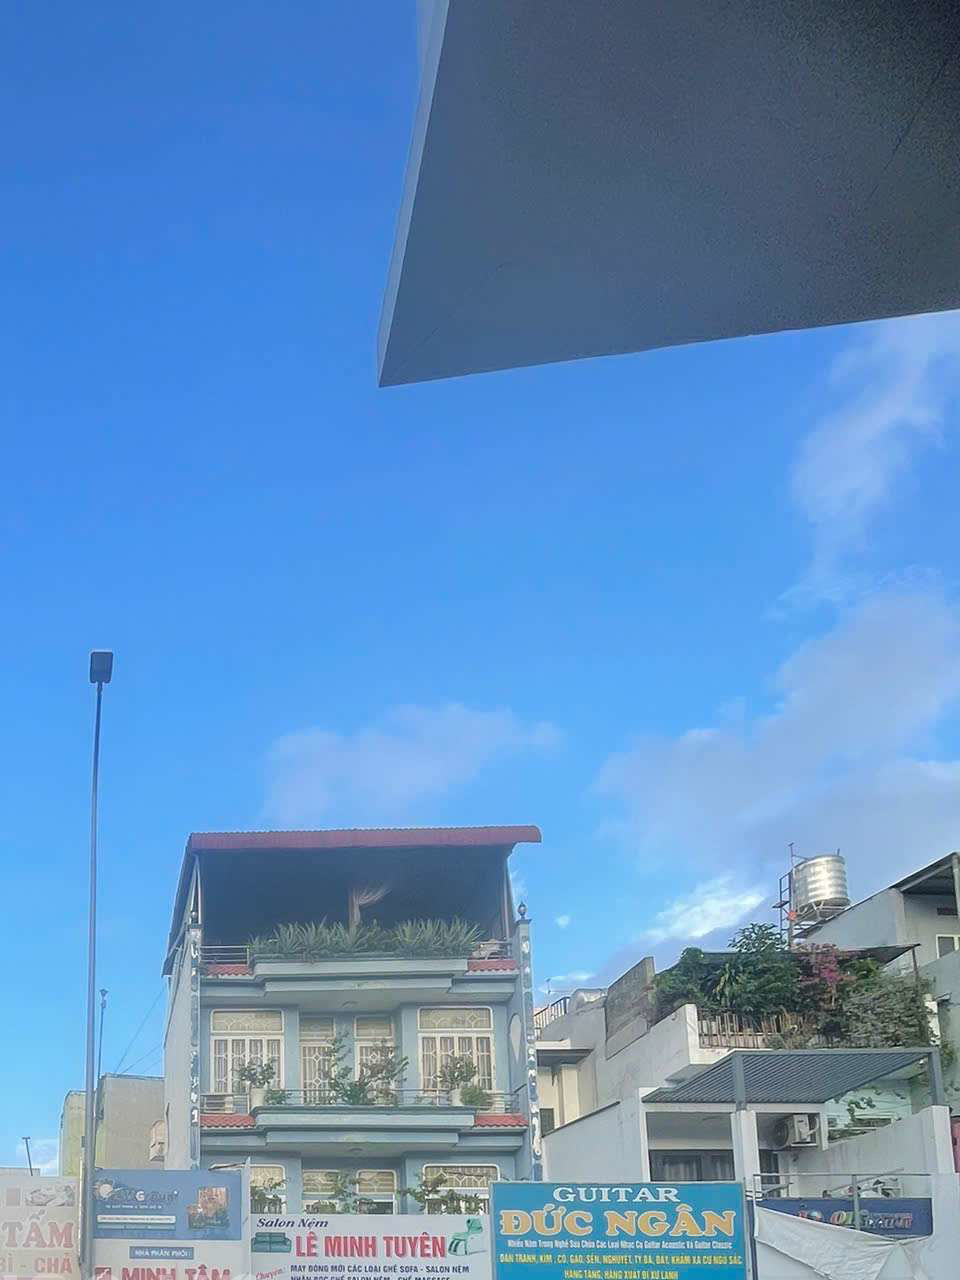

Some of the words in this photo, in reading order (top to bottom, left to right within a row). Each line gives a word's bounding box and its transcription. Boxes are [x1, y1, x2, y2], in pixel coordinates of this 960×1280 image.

[553, 1187, 680, 1202] GUITAR
[1, 1210, 74, 1248] TẤM
[257, 1218, 295, 1228] Salon
[298, 1218, 328, 1230] Nệm
[500, 1204, 593, 1236] ĐỨC
[604, 1204, 736, 1237] NGÂN
[296, 1231, 319, 1258] LÊ
[325, 1236, 377, 1258] MINH
[383, 1232, 447, 1258] TUYÊN
